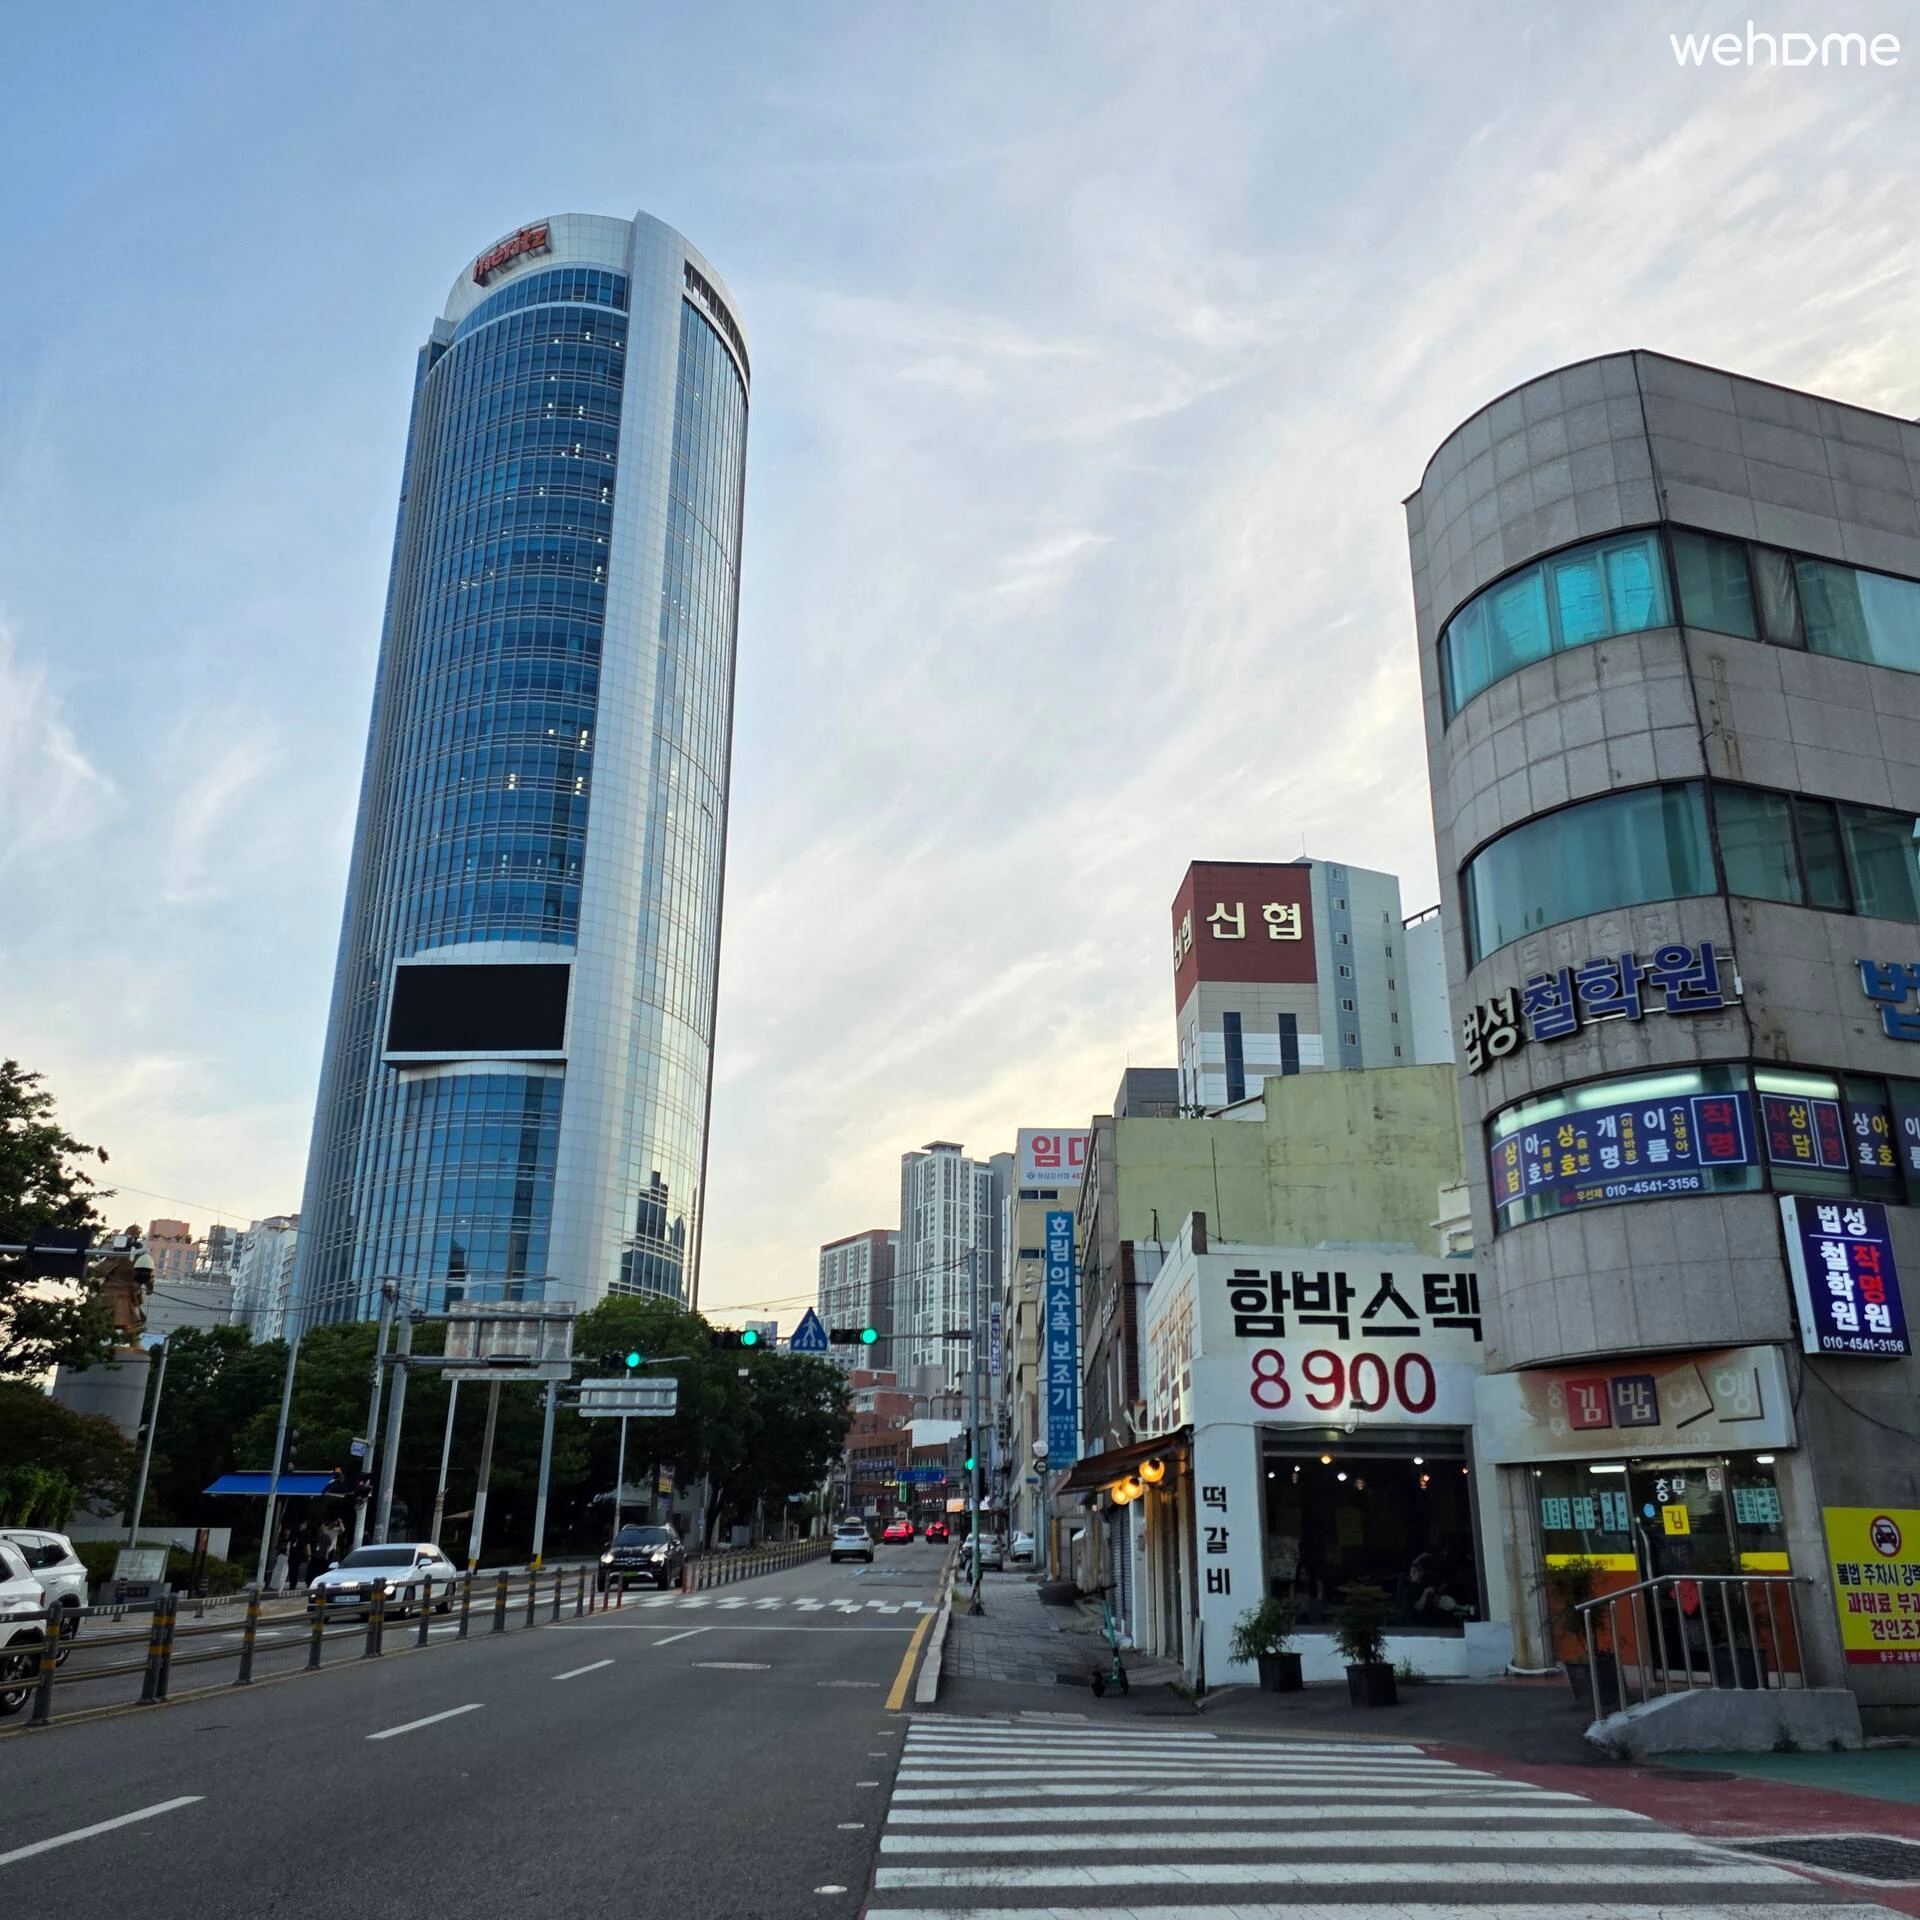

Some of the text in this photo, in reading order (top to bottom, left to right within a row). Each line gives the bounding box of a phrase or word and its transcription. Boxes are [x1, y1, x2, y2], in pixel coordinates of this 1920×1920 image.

[1206, 902, 1302, 940] 신협
[1522, 941, 1725, 1042] 철학원
[1557, 1124, 1578, 1176] 상호
[1596, 1115, 1620, 1169] 개명
[1643, 1108, 1670, 1163] 이름
[1703, 1103, 1736, 1156] 작명
[1788, 1105, 1811, 1158] 상담
[1853, 1113, 1876, 1165] 상호
[1872, 1115, 1896, 1167] 아호
[1605, 1176, 1701, 1197] 010-4541-3156
[1817, 1205, 1867, 1236] 법성
[1226, 1268, 1483, 1342] 함박스텍
[1820, 1241, 1860, 1331] 철학원
[1853, 1245, 1892, 1333] 작명원
[1823, 1335, 1905, 1352] 010-4541-3156
[1051, 1341, 1073, 1410] 보조기
[1250, 1348, 1436, 1414] 8900
[1202, 1486, 1231, 1595] 떡갈비
[1836, 1563, 1861, 1585] 불법
[1863, 1563, 1899, 1586] 주차시
